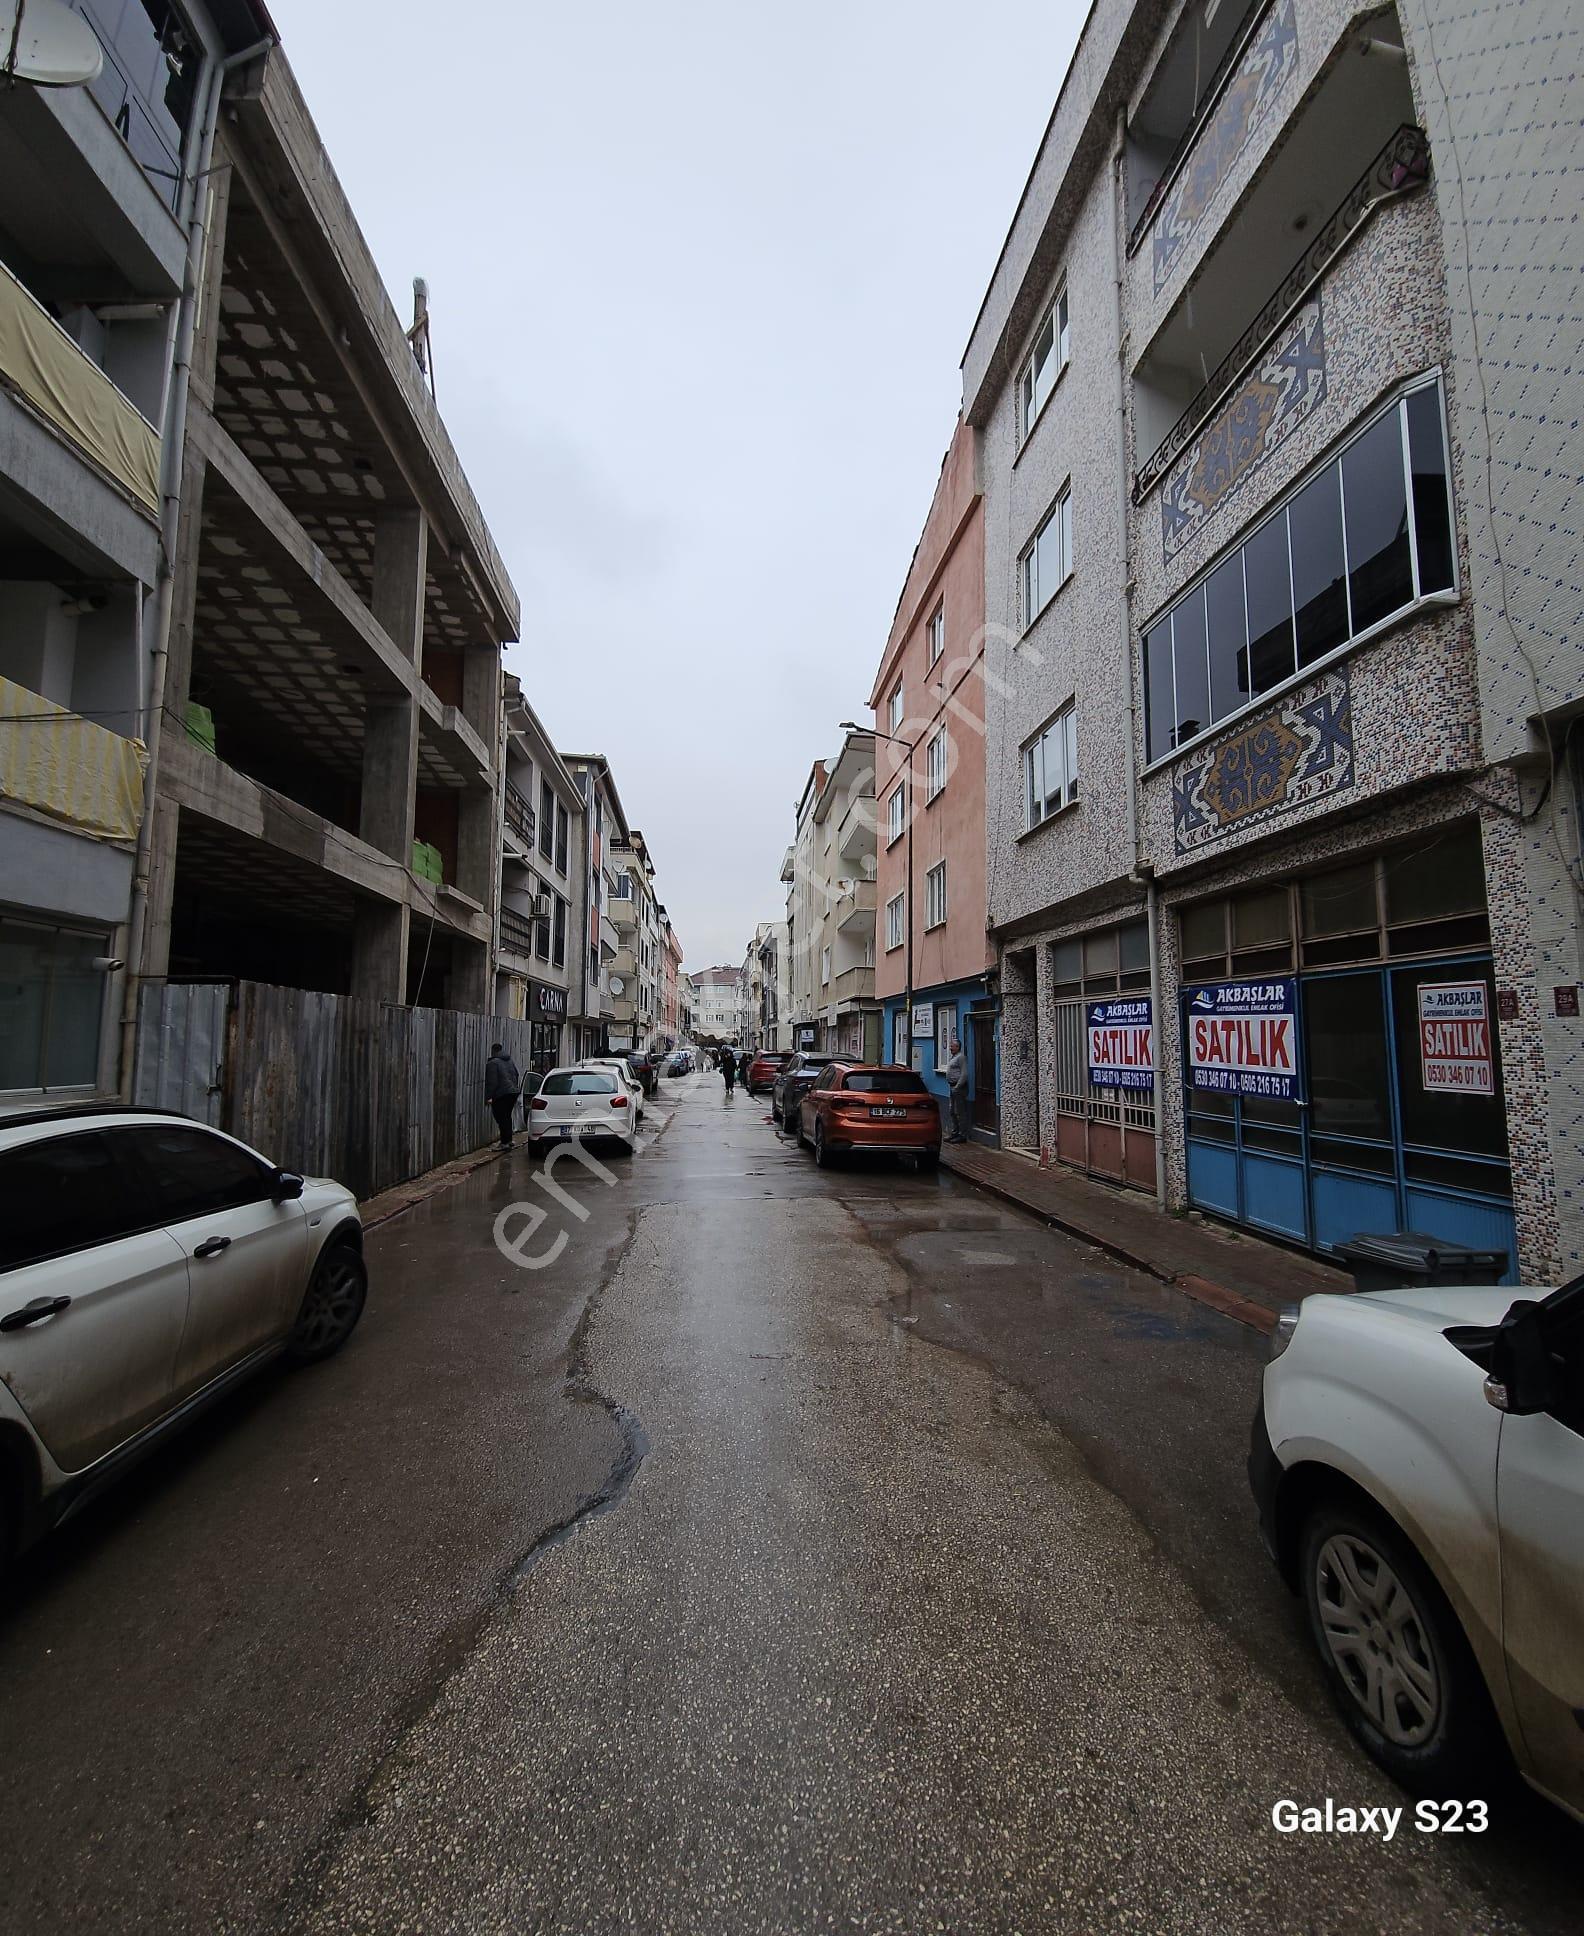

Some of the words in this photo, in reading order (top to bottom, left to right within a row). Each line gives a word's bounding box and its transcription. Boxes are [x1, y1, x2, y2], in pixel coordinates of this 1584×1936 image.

[1216, 984, 1285, 1004] AKBAŞLAR
[1437, 990, 1483, 1006] AKBAŞLAR
[1106, 1003, 1148, 1018] AKBAŞLAR
[1093, 1029, 1152, 1066] SATILIK
[1195, 1019, 1290, 1068] SATILIK
[1424, 1022, 1487, 1057] SATILIK
[1195, 1069, 1208, 1085] 0530
[1208, 1071, 1219, 1088] 346
[1219, 1072, 1228, 1089] 07
[1229, 1073, 1237, 1090] 10
[1257, 1075, 1270, 1094] 216
[1271, 1077, 1280, 1095] 75
[1281, 1078, 1290, 1097] 17
[1427, 1065, 1446, 1084] 0530
[1448, 1066, 1463, 1085] 346
[1465, 1066, 1475, 1086] 07
[1477, 1067, 1488, 1086] 10
